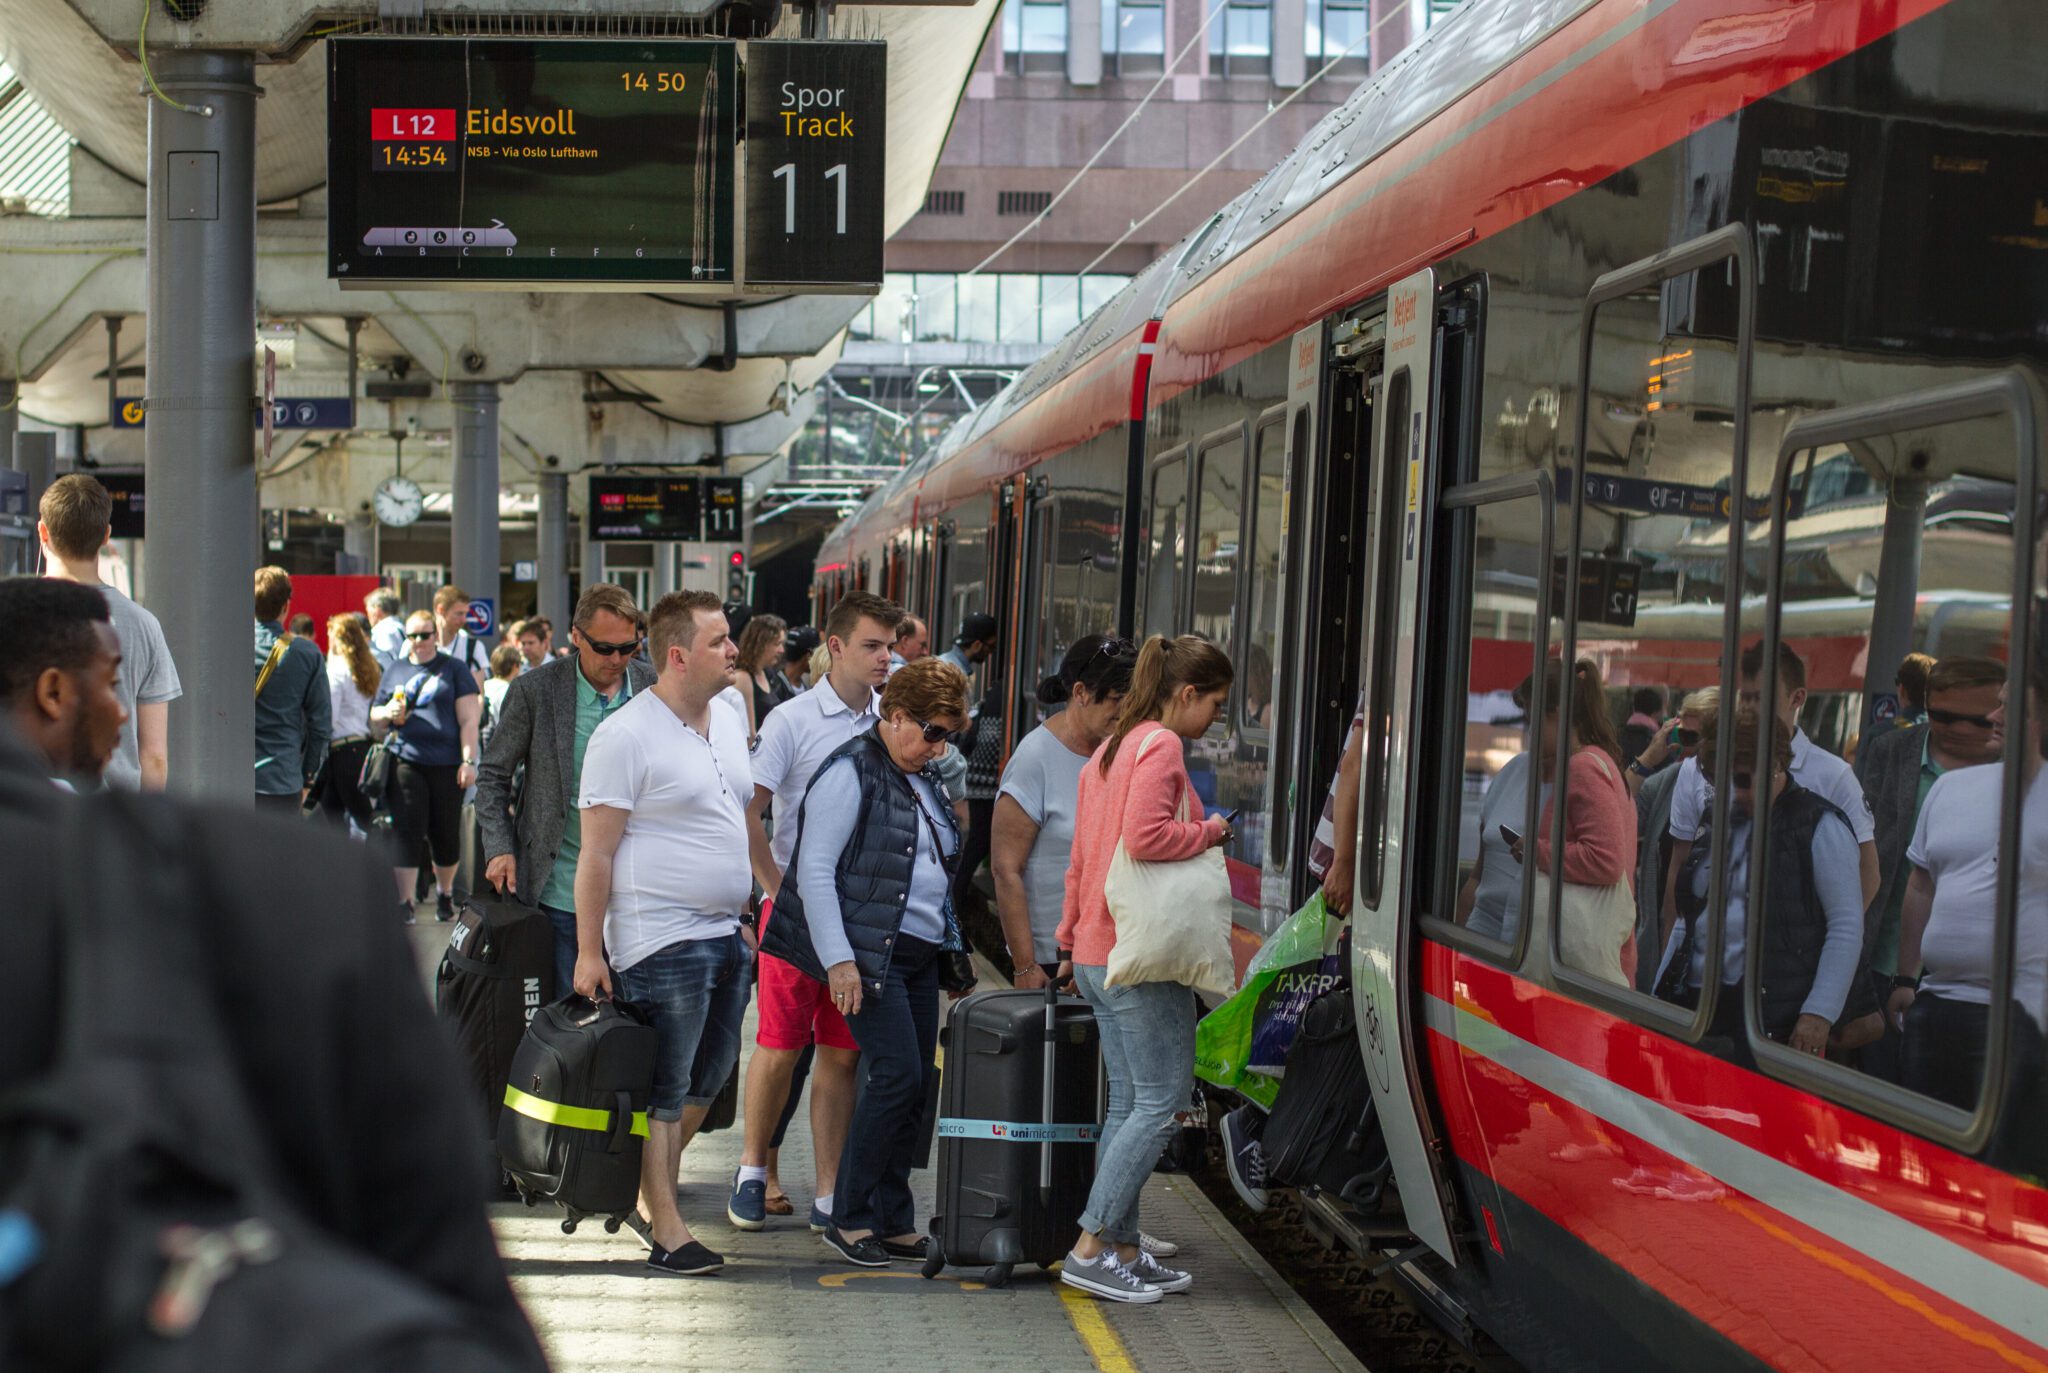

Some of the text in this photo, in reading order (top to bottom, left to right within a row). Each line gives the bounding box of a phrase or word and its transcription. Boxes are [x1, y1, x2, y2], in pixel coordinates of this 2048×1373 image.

[781, 82, 845, 112] Spor
[466, 109, 577, 134] Eidsvoll
[780, 111, 854, 136] Track
[383, 146, 448, 165] 14:54
[467, 147, 491, 157] NSB
[502, 147, 519, 157] Via
[522, 147, 547, 157] Oslo
[550, 147, 598, 158] Lufthavn
[772, 163, 847, 234] 11
[375, 247, 643, 257] A B C D E F G
[711, 508, 735, 531] 11
[1275, 973, 1350, 995] TAXFR
[524, 977, 541, 1029] SEN
[1011, 1127, 1057, 1139] unimicro
